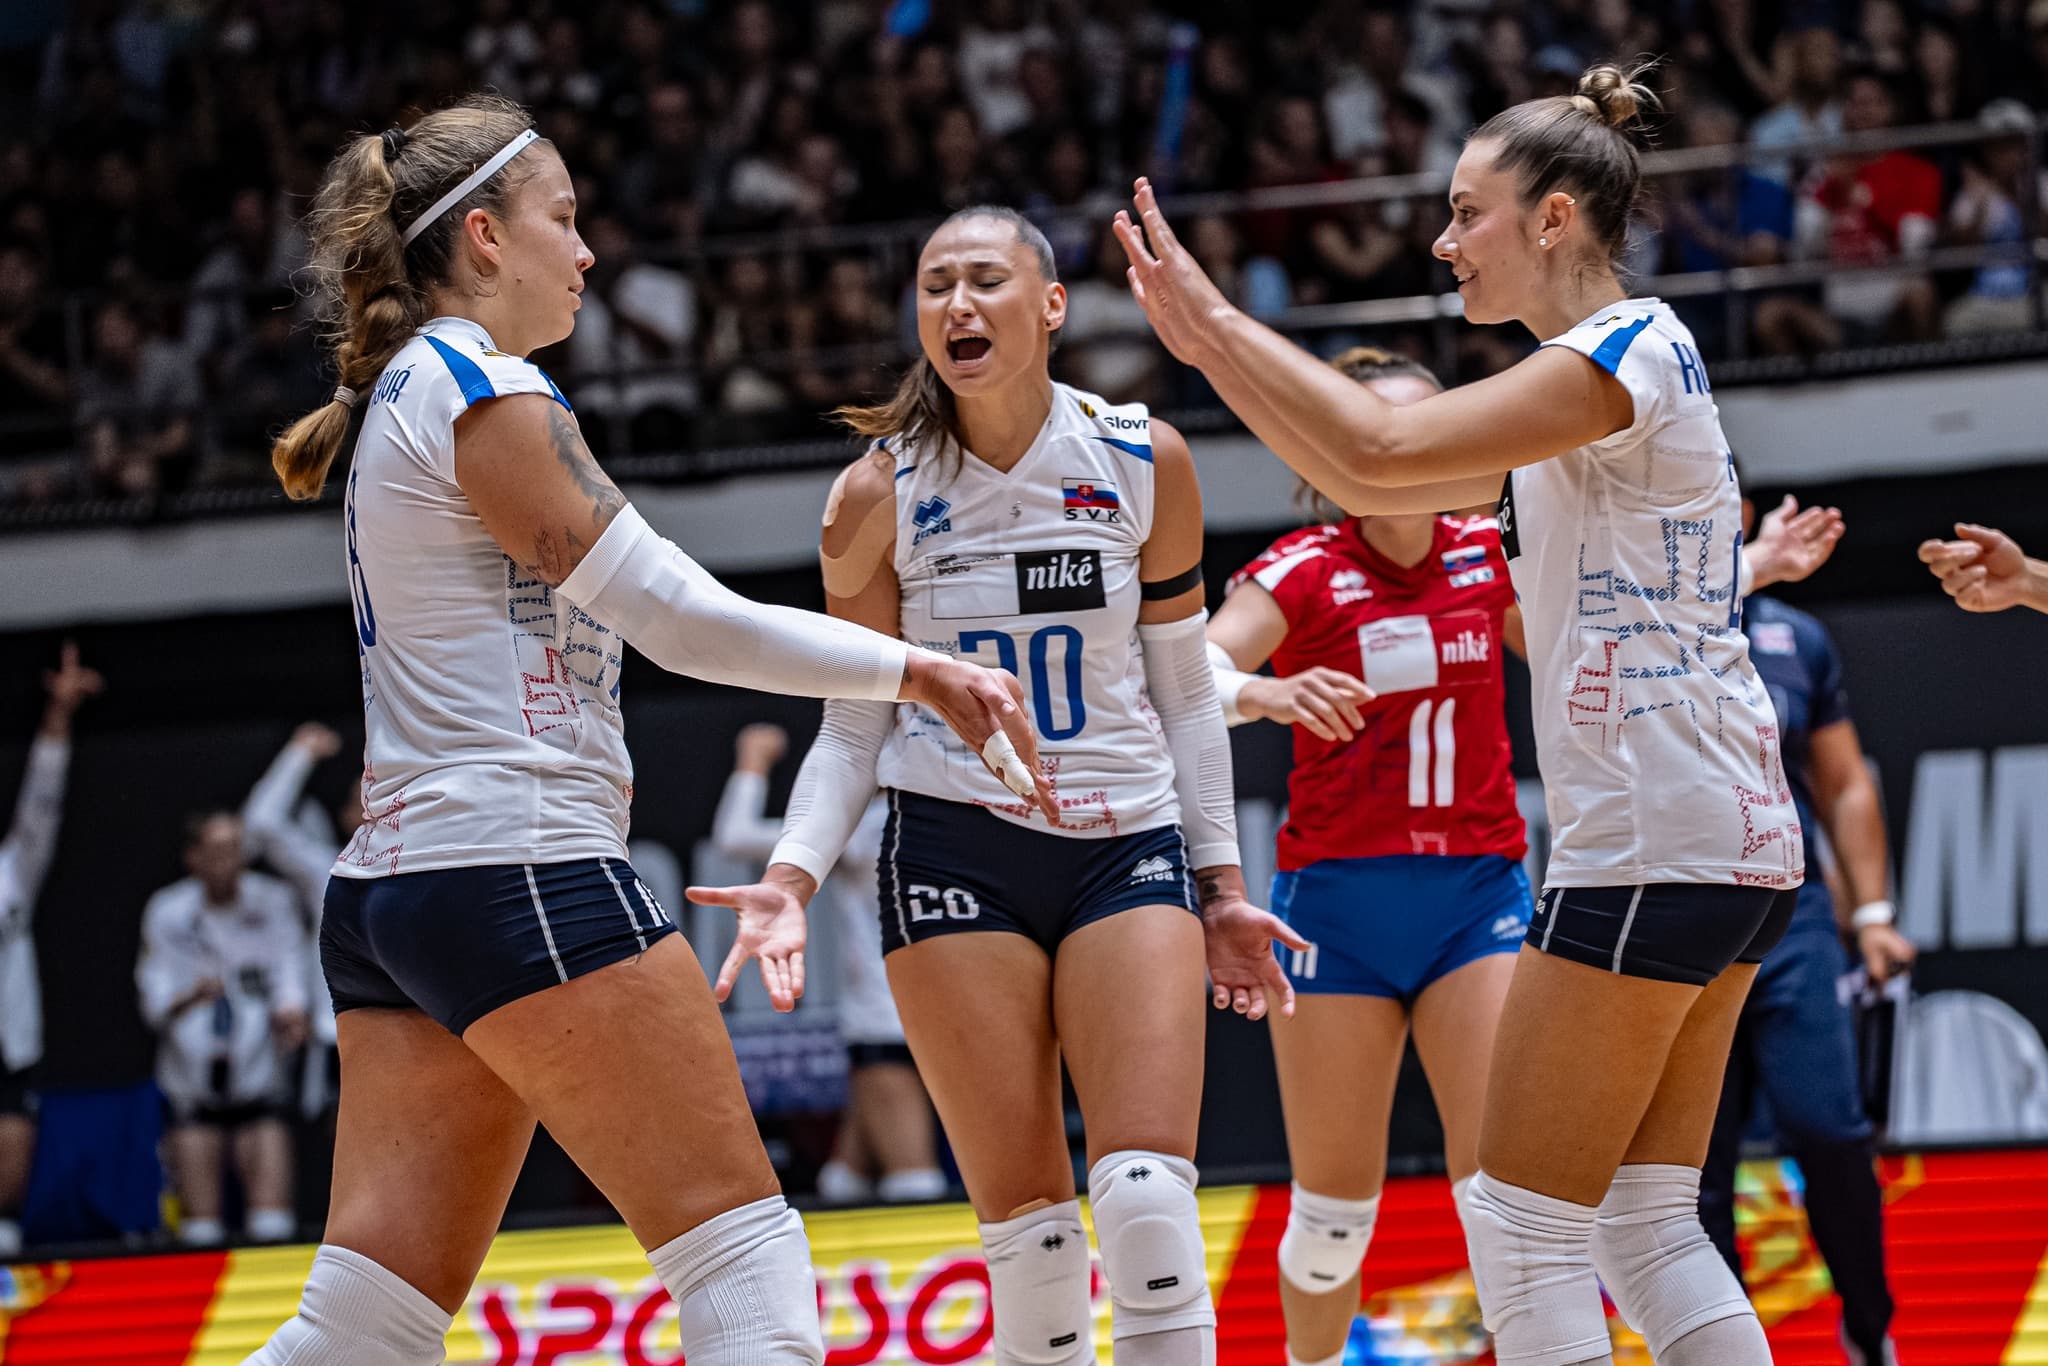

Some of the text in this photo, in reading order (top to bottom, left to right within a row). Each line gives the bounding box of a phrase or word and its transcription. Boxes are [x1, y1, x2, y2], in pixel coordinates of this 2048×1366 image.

[1026, 553, 1094, 590] niké
[1408, 697, 1456, 807] 11
[908, 884, 980, 922] 20
